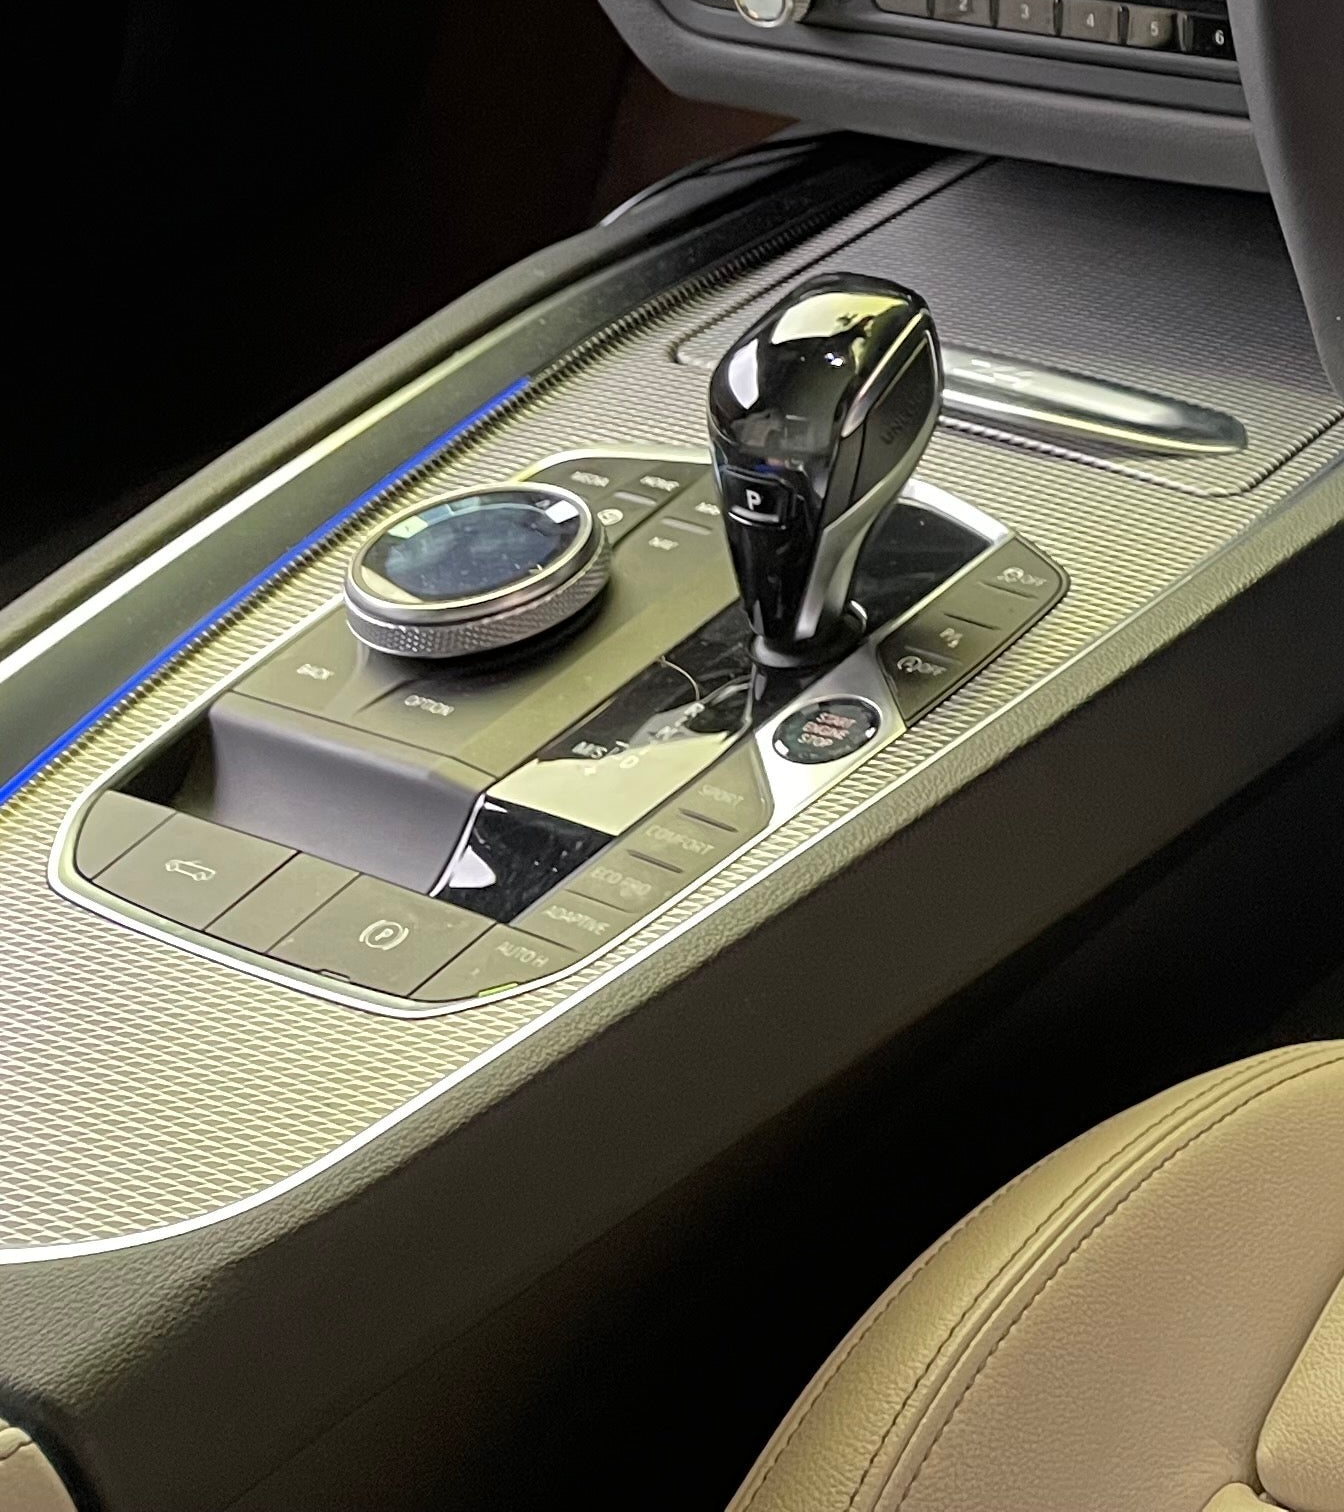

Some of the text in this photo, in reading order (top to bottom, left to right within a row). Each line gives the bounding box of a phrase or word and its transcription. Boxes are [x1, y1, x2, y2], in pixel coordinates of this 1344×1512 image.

[1020, 4, 1030, 20] 3
[1086, 13, 1096, 28] 4
[1215, 29, 1225, 45] 6
[745, 489, 762, 510] P
[497, 940, 534, 964] AUTO
